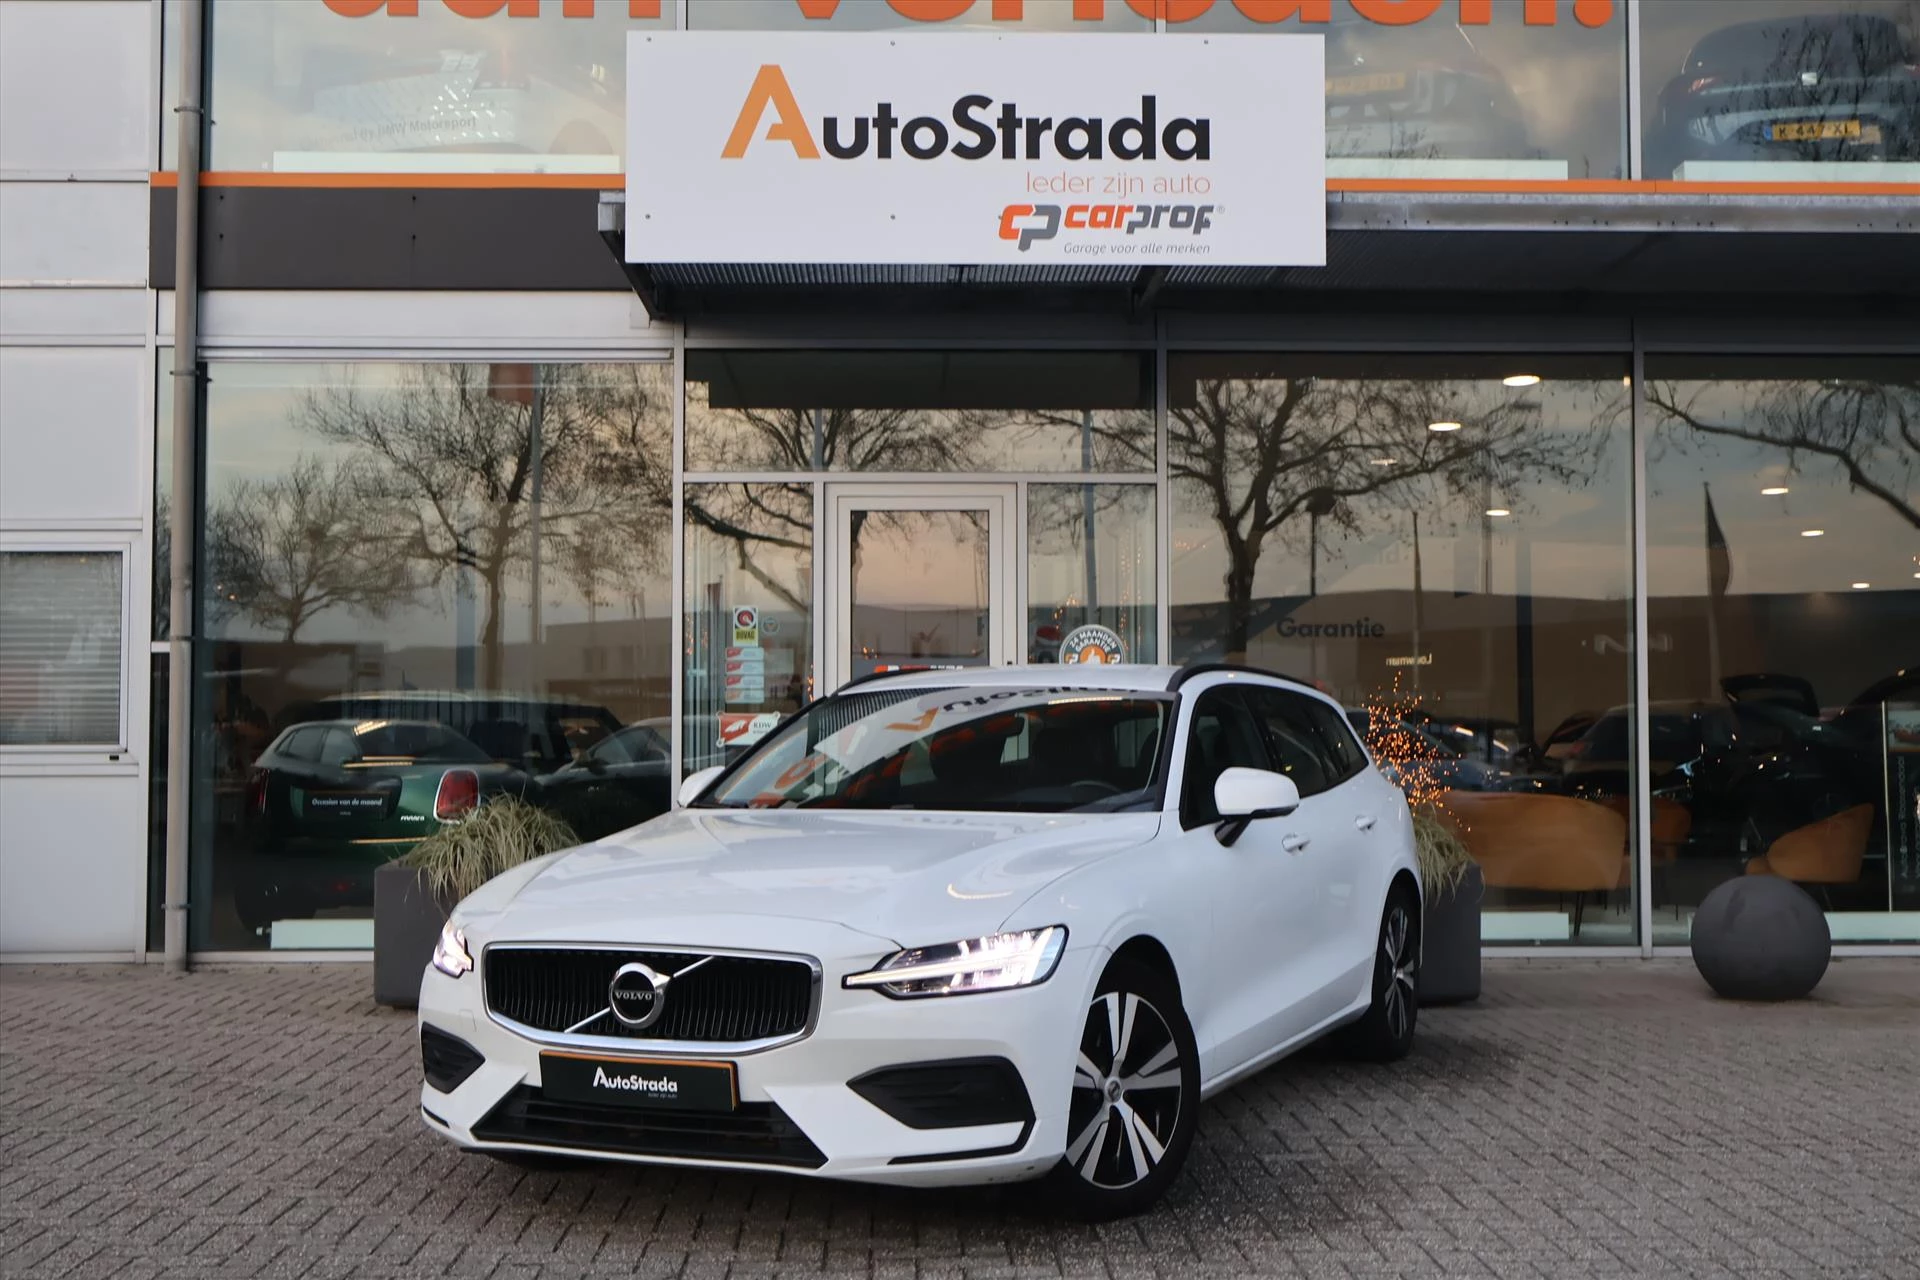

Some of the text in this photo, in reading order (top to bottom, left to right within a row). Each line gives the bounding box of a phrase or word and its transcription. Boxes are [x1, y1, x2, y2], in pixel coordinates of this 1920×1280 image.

[721, 64, 1211, 161] AutoStrada
[409, 116, 477, 133] Motorsport
[1026, 172, 1211, 199] Ieder zijn auto
[1063, 242, 1210, 255] Garage voor alle merken
[1276, 617, 1385, 638] Garantie
[1075, 638, 1111, 653] GARANTIE
[1080, 630, 1117, 649] MAANDEN
[311, 797, 383, 806] Occasion van de maand
[615, 991, 654, 1000] VOLVO
[593, 1066, 678, 1092] AutoStrada
